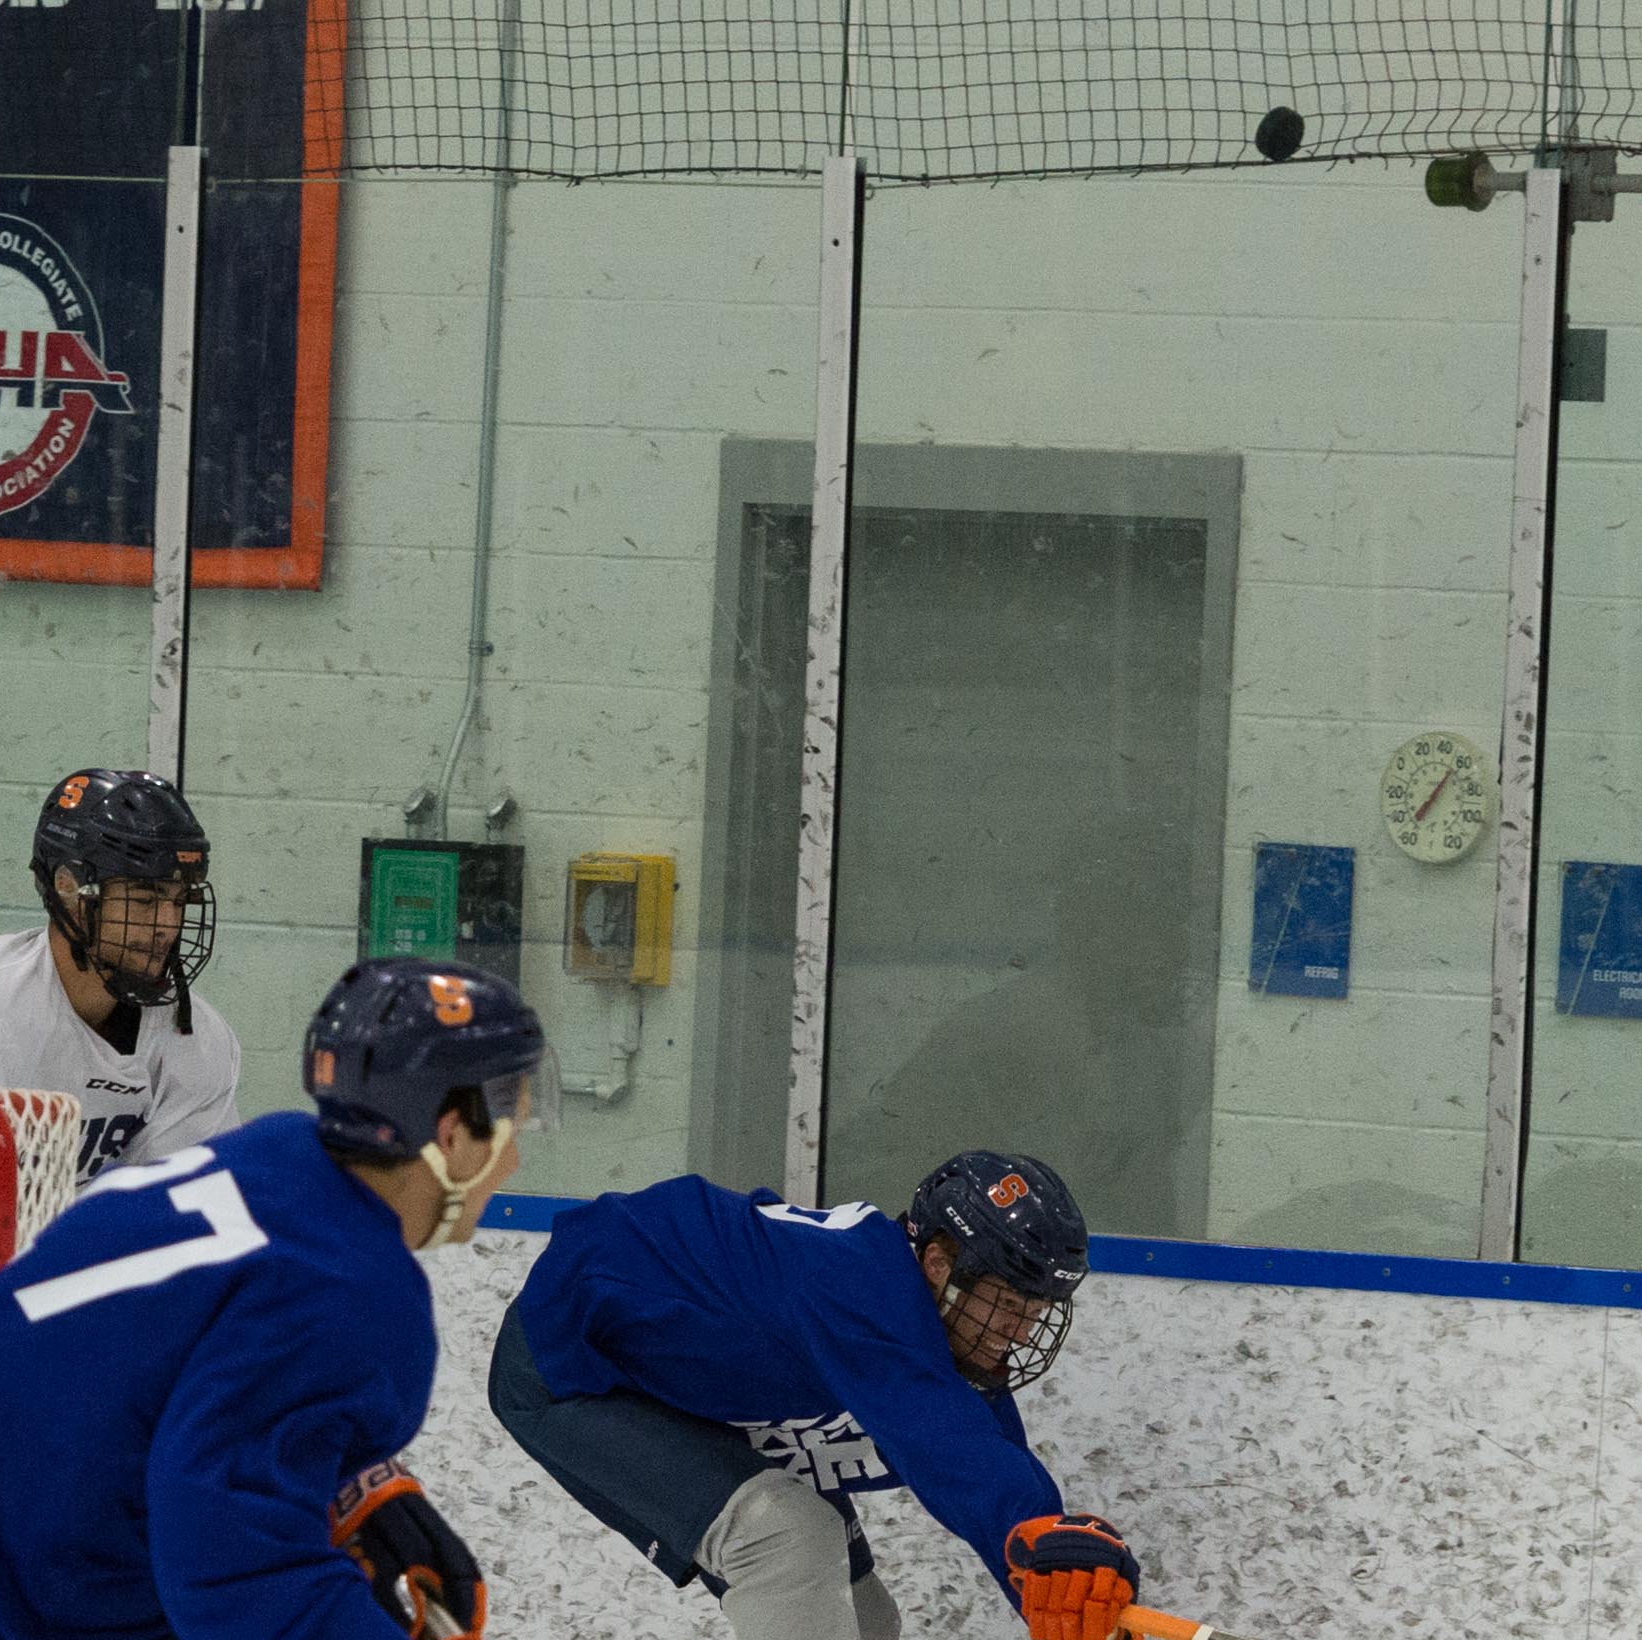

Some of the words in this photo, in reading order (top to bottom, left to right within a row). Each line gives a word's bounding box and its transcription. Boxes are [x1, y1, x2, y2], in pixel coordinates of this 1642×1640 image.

[1415, 742, 1430, 756] 20
[1437, 740, 1453, 754] 40
[1396, 757, 1406, 770] 0
[1456, 755, 1472, 769] 60
[85, 1078, 147, 1095] CCM
[946, 1206, 974, 1237] CCM
